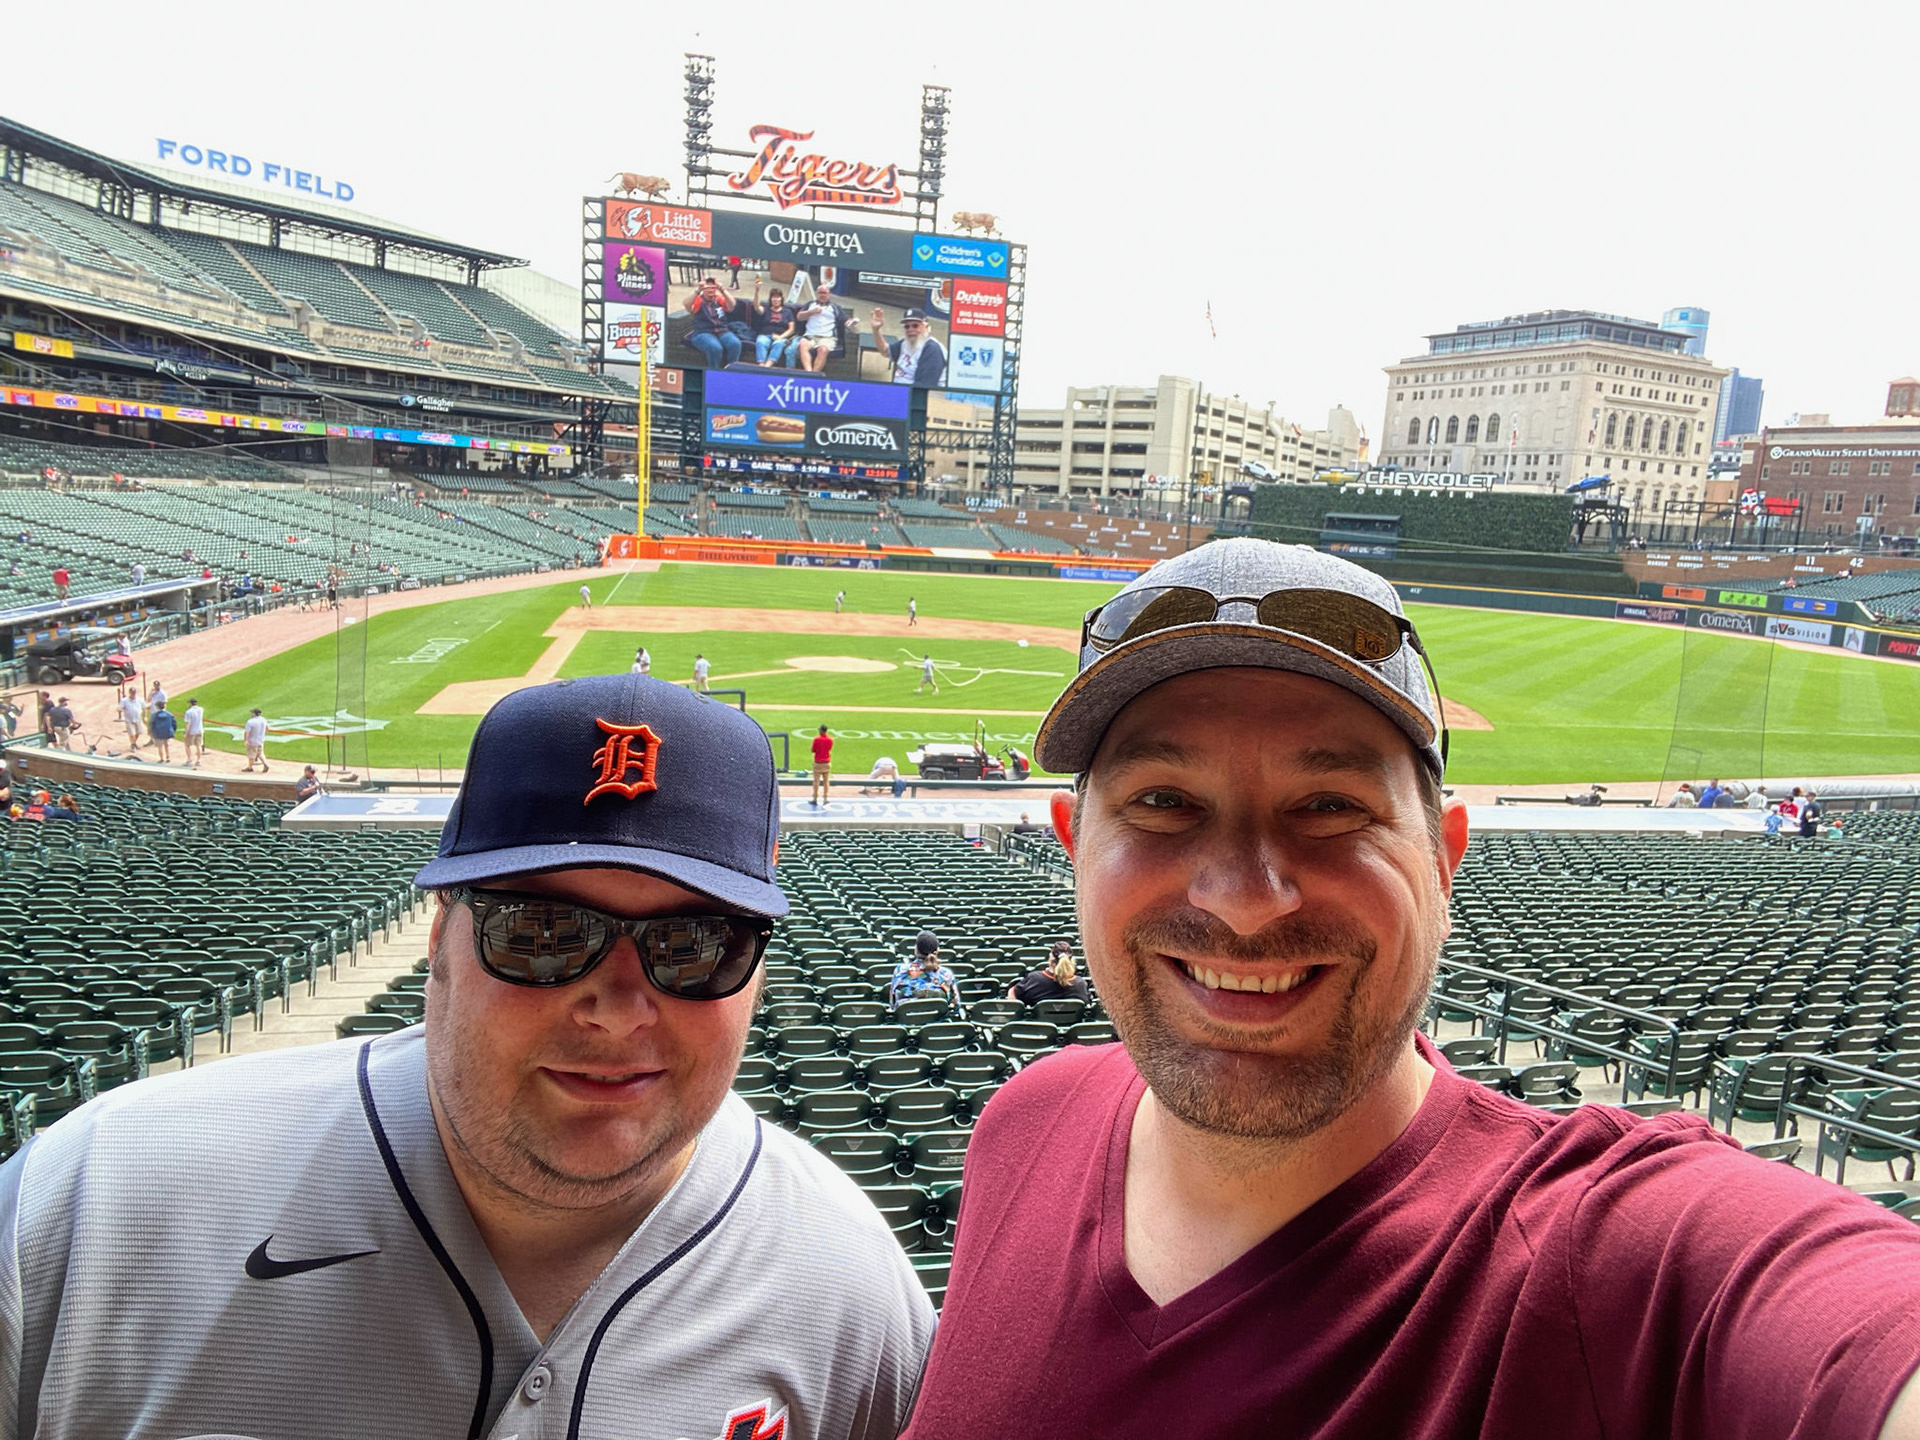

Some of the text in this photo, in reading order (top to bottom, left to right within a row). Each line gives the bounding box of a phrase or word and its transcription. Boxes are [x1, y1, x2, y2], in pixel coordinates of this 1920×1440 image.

[156, 138, 354, 202] FORD FIELD
[728, 124, 900, 208] Tigers
[664, 210, 702, 230] Little
[652, 222, 707, 243] Caesars
[791, 245, 838, 258] PARK
[940, 245, 982, 258] Children's
[936, 255, 985, 268] Foundation
[617, 272, 647, 283] planet
[621, 279, 653, 290] fitness
[956, 291, 1003, 307] Dunham's
[957, 317, 999, 328] LOW PRICES
[973, 312, 998, 320] NAMES
[646, 309, 658, 386] ROCKET
[416, 395, 454, 407] Gallagher
[767, 379, 850, 412] xfinity
[1783, 448, 1812, 458] GRAND
[1812, 448, 1842, 458] VALLEY
[1842, 448, 1867, 458] STATE
[751, 461, 773, 470] GAME
[818, 465, 831, 474] PM
[1365, 470, 1498, 489] CHEVROLET
[1340, 487, 1474, 499] FOUNTAIN
[1805, 556, 1815, 565] 11
[1849, 557, 1864, 568] 42
[1797, 631, 1827, 640] VISION
[584, 717, 662, 806] D
